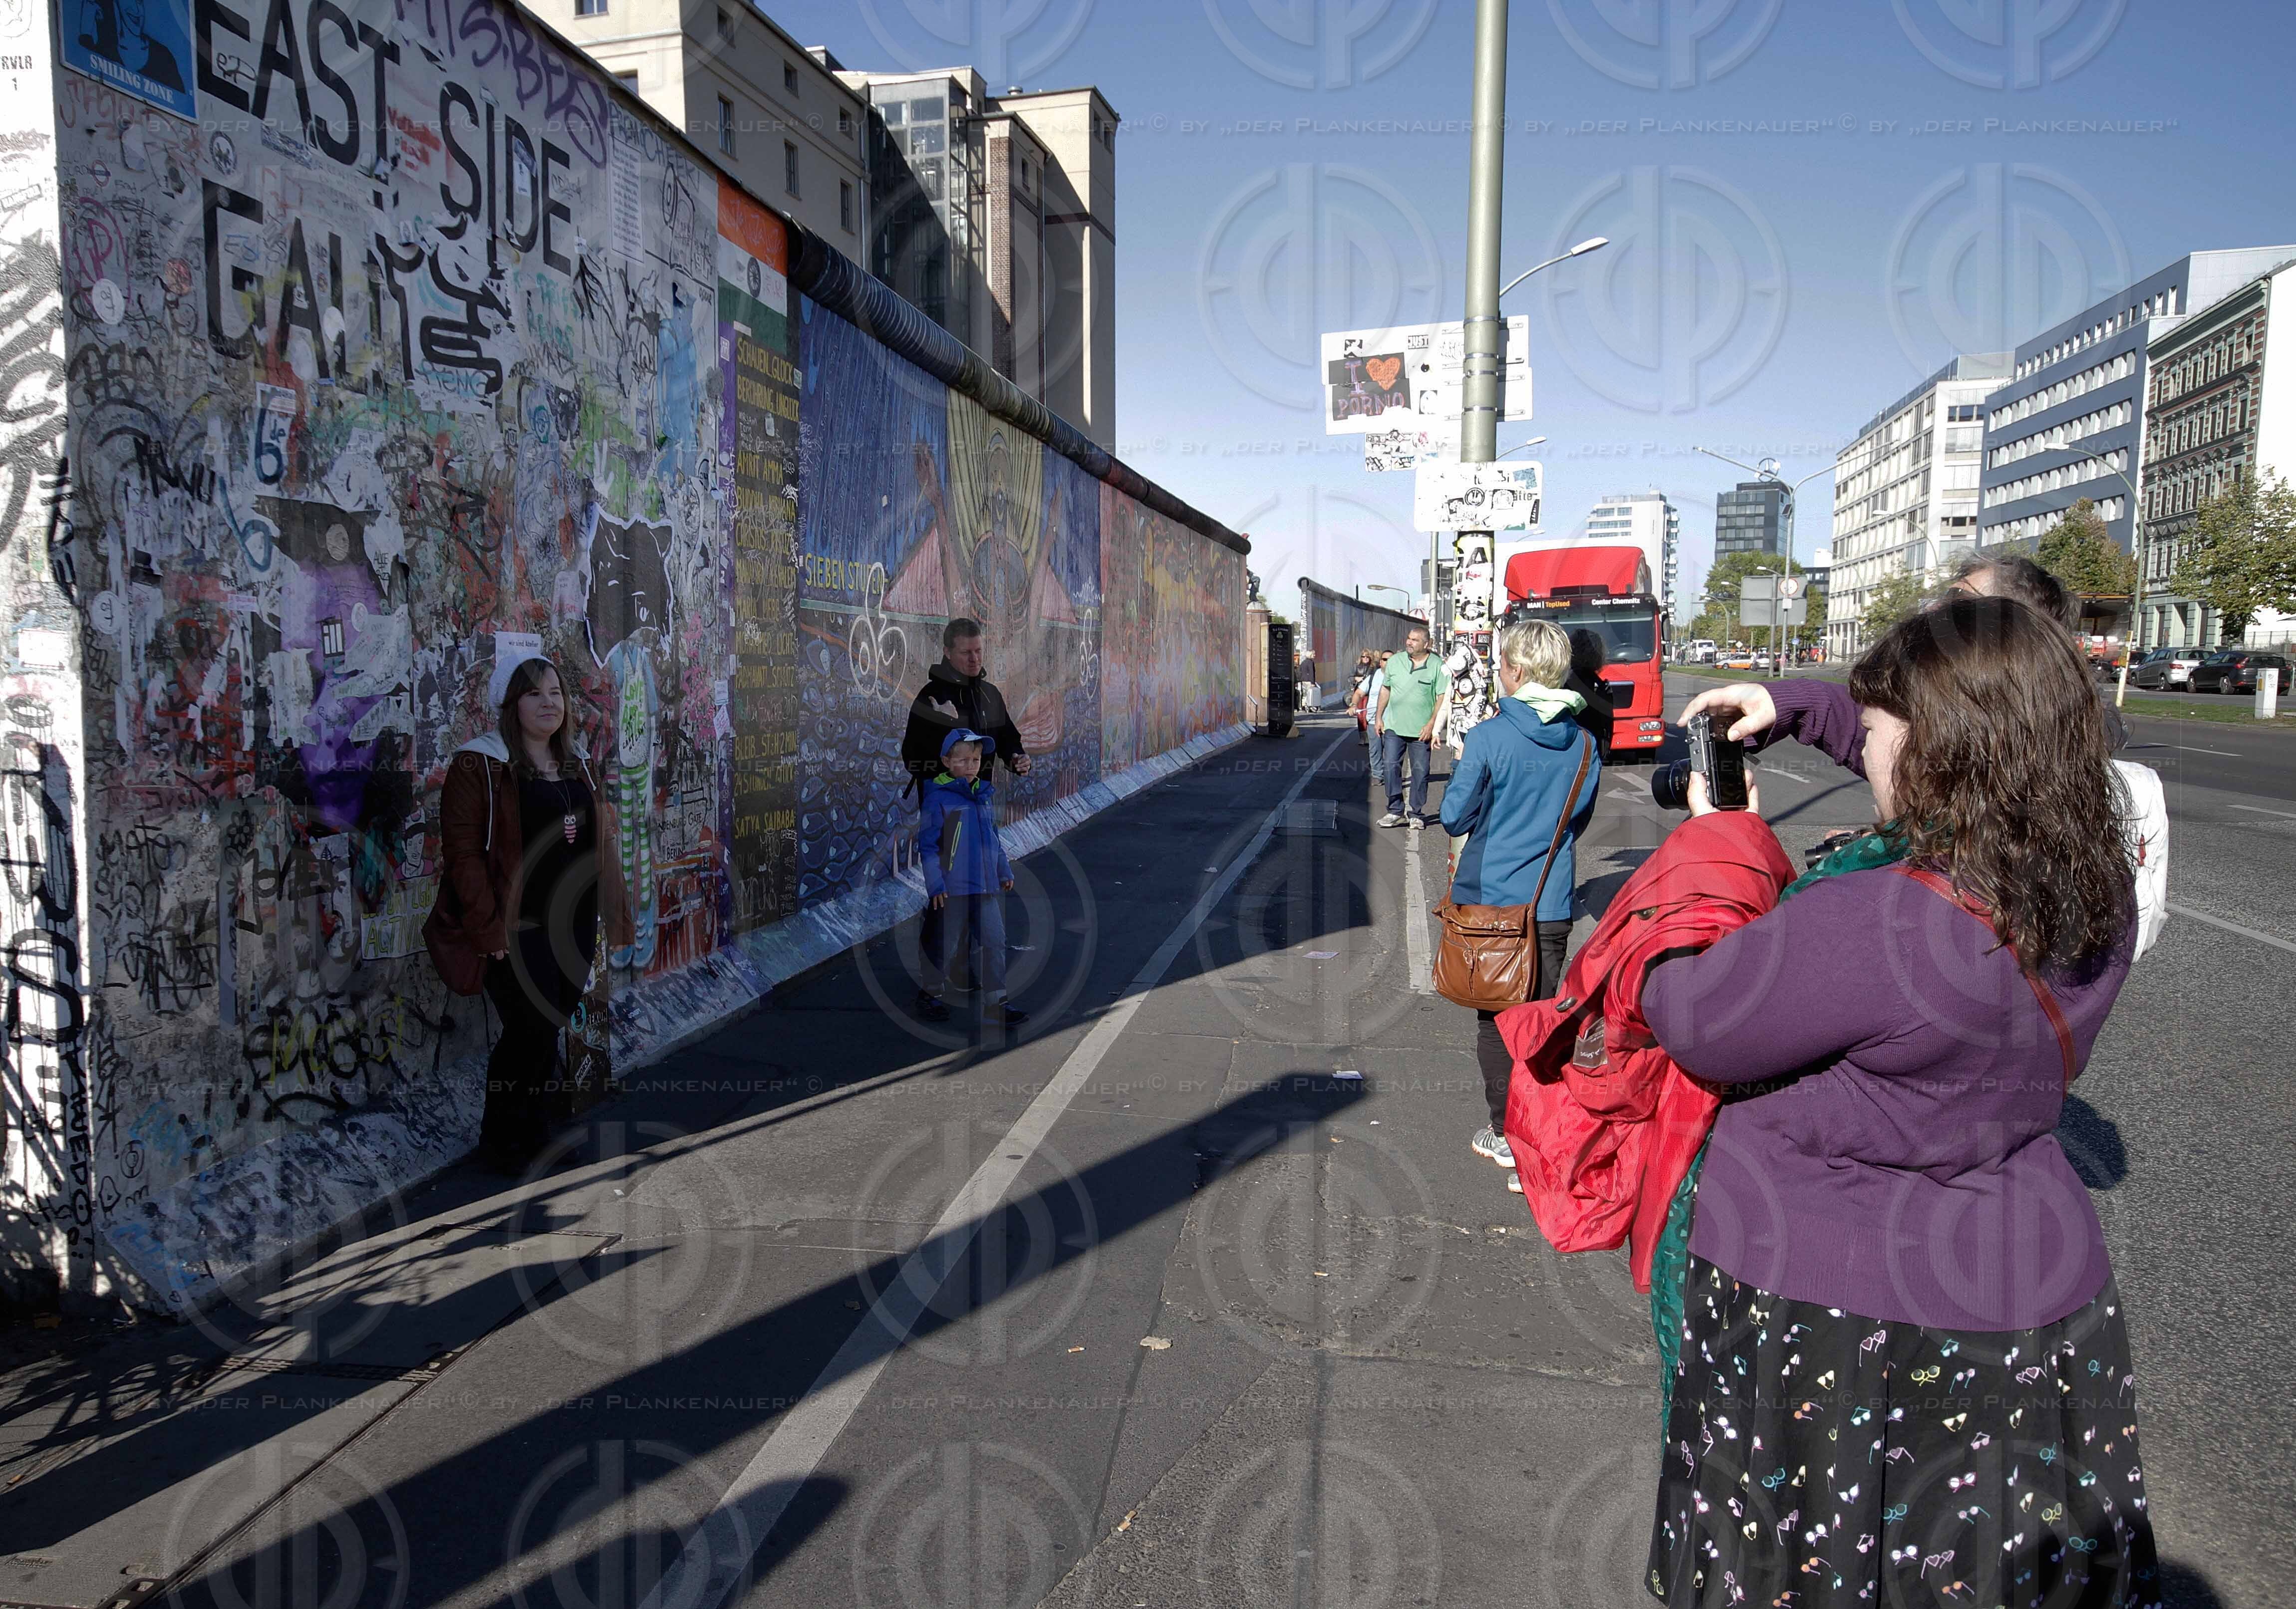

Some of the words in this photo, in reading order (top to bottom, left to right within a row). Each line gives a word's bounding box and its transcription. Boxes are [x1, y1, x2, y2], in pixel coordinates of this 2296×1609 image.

[90, 53, 142, 89] SMILING
[143, 78, 174, 104] ZONE
[1337, 391, 1406, 418] PORNO
[736, 451, 760, 479] AMRIT
[806, 552, 845, 591] SIEBEN
[688, 811, 704, 826] GATE
[734, 814, 760, 839] SATYA
[364, 912, 428, 958] ACTIVIS
